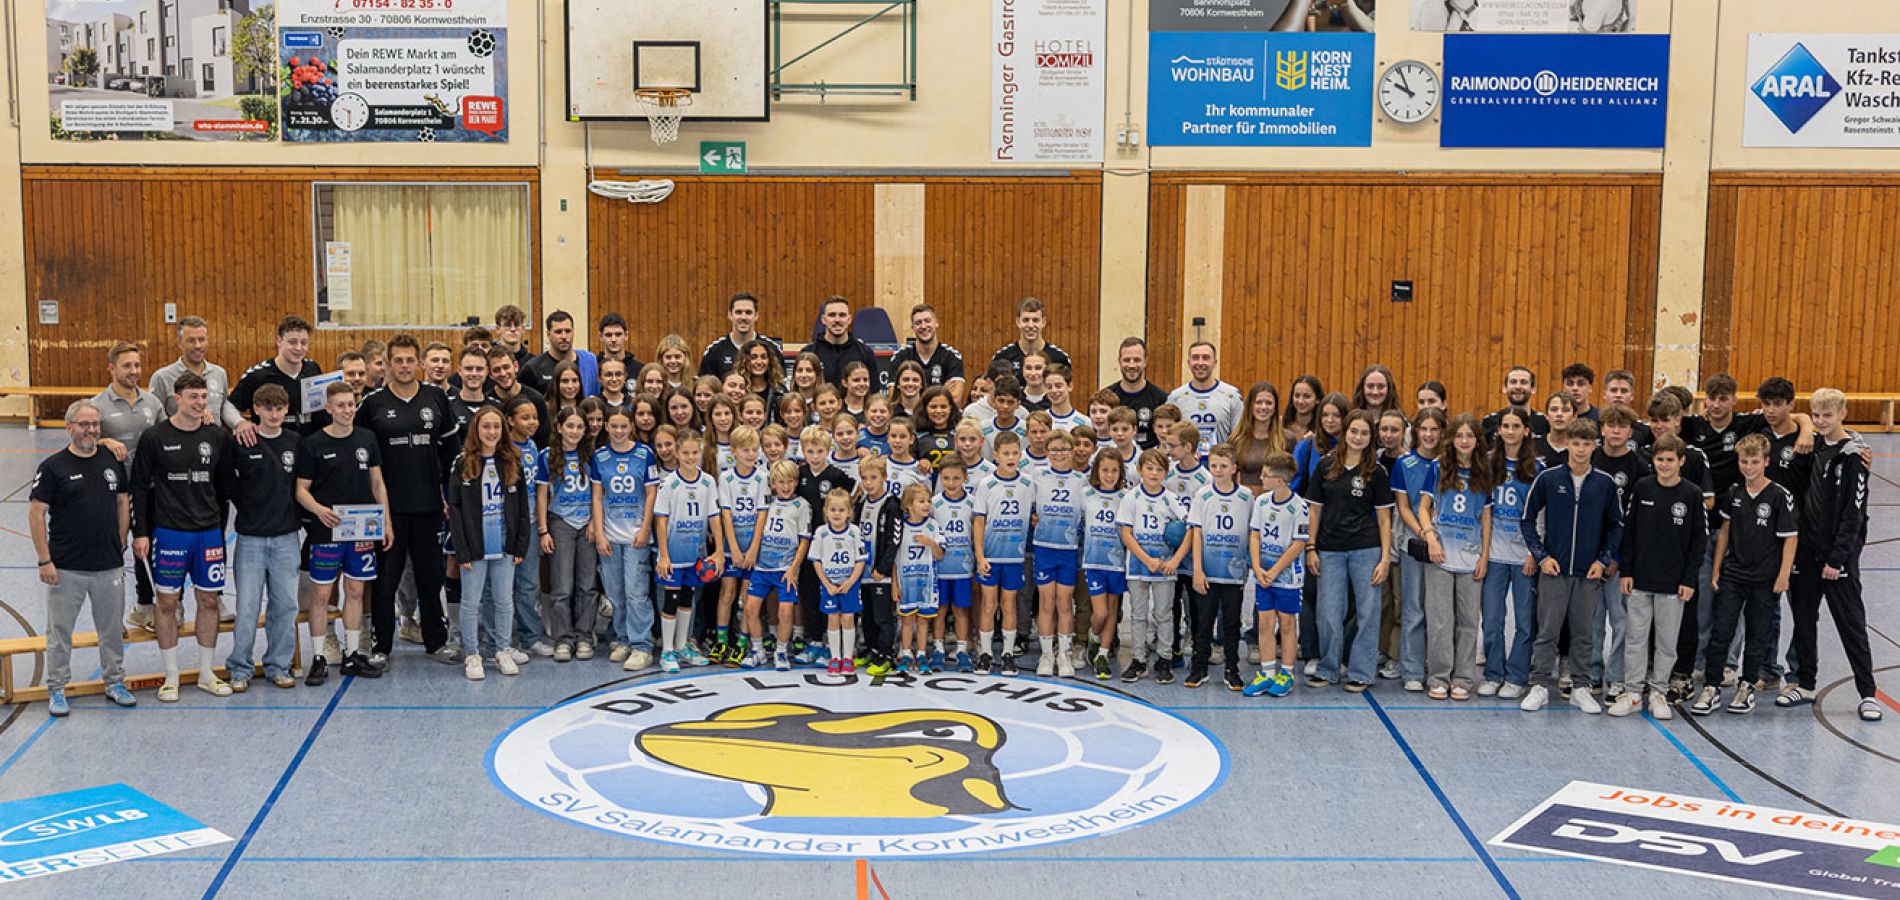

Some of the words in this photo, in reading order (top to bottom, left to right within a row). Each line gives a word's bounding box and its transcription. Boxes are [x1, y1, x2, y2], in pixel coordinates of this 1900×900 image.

[352, 0, 390, 9] 07154
[419, 0, 434, 9] 35
[1206, 7, 1264, 17] Kornwestheim
[300, 14, 357, 25] Enzstrasse
[358, 15, 372, 25] 30
[380, 15, 412, 25] 70806
[413, 14, 487, 25] Kornwestheim
[1034, 39, 1092, 53] HOTEL
[346, 48, 370, 60] Dein
[373, 48, 401, 60] REWE
[407, 48, 437, 60] Markt
[441, 50, 457, 60] am
[1035, 53, 1094, 68] DOMIZIL
[1206, 56, 1254, 66] STÄDTISCHE
[1311, 51, 1353, 64] KORN
[346, 64, 432, 77] Salamanderplatz
[433, 65, 440, 75] 1
[442, 63, 485, 76] wünscht
[1171, 67, 1254, 83] WOHNBAU
[1310, 64, 1351, 77] WEST
[346, 80, 363, 90] ein
[365, 79, 438, 90] beerenstarkes
[440, 79, 470, 91] Spiel!
[1310, 77, 1351, 90] HEIM.
[1451, 77, 1531, 91] RAIMONDO
[1560, 77, 1659, 91] HEIDENREICH
[1760, 75, 1832, 98] ARAL
[468, 101, 497, 111] REWE
[1450, 97, 1577, 106] GENERALVERTRETUNG
[1582, 97, 1603, 106] DER
[1608, 97, 1659, 106] ALLIANZ
[996, 64, 1019, 160] Renninger
[1205, 104, 1225, 117] Ihr
[1229, 104, 1315, 117] kommunaler
[1844, 115, 1870, 125] Gregor
[1181, 121, 1232, 135] Partner
[1236, 121, 1255, 135] für
[1258, 121, 1337, 135] Immobilien
[482, 481, 505, 500] 14
[564, 474, 589, 494] 30
[610, 475, 636, 494] 69
[1050, 488, 1070, 503] 22
[1453, 492, 1467, 513] 8
[1494, 484, 1518, 507] 16
[686, 501, 700, 516] 11
[735, 497, 755, 511] 53
[1000, 499, 1020, 516] 23
[1094, 508, 1115, 524] 49
[1141, 514, 1159, 530] 13
[1215, 514, 1235, 531] 10
[768, 516, 784, 533] 15
[945, 519, 965, 533] 48
[830, 550, 850, 565] 46
[907, 545, 926, 561] 57
[590, 684, 720, 716] DIE
[742, 673, 1105, 713] LURCHIS
[1598, 790, 1701, 813] Jobs
[1714, 804, 1756, 821] in
[28, 808, 149, 838] SWLB
[538, 791, 598, 814] SV
[595, 808, 862, 854] Salamander
[878, 793, 1178, 854] Kornwestheim
[1550, 818, 1804, 867] DSV
[1807, 867, 1869, 884] Global
